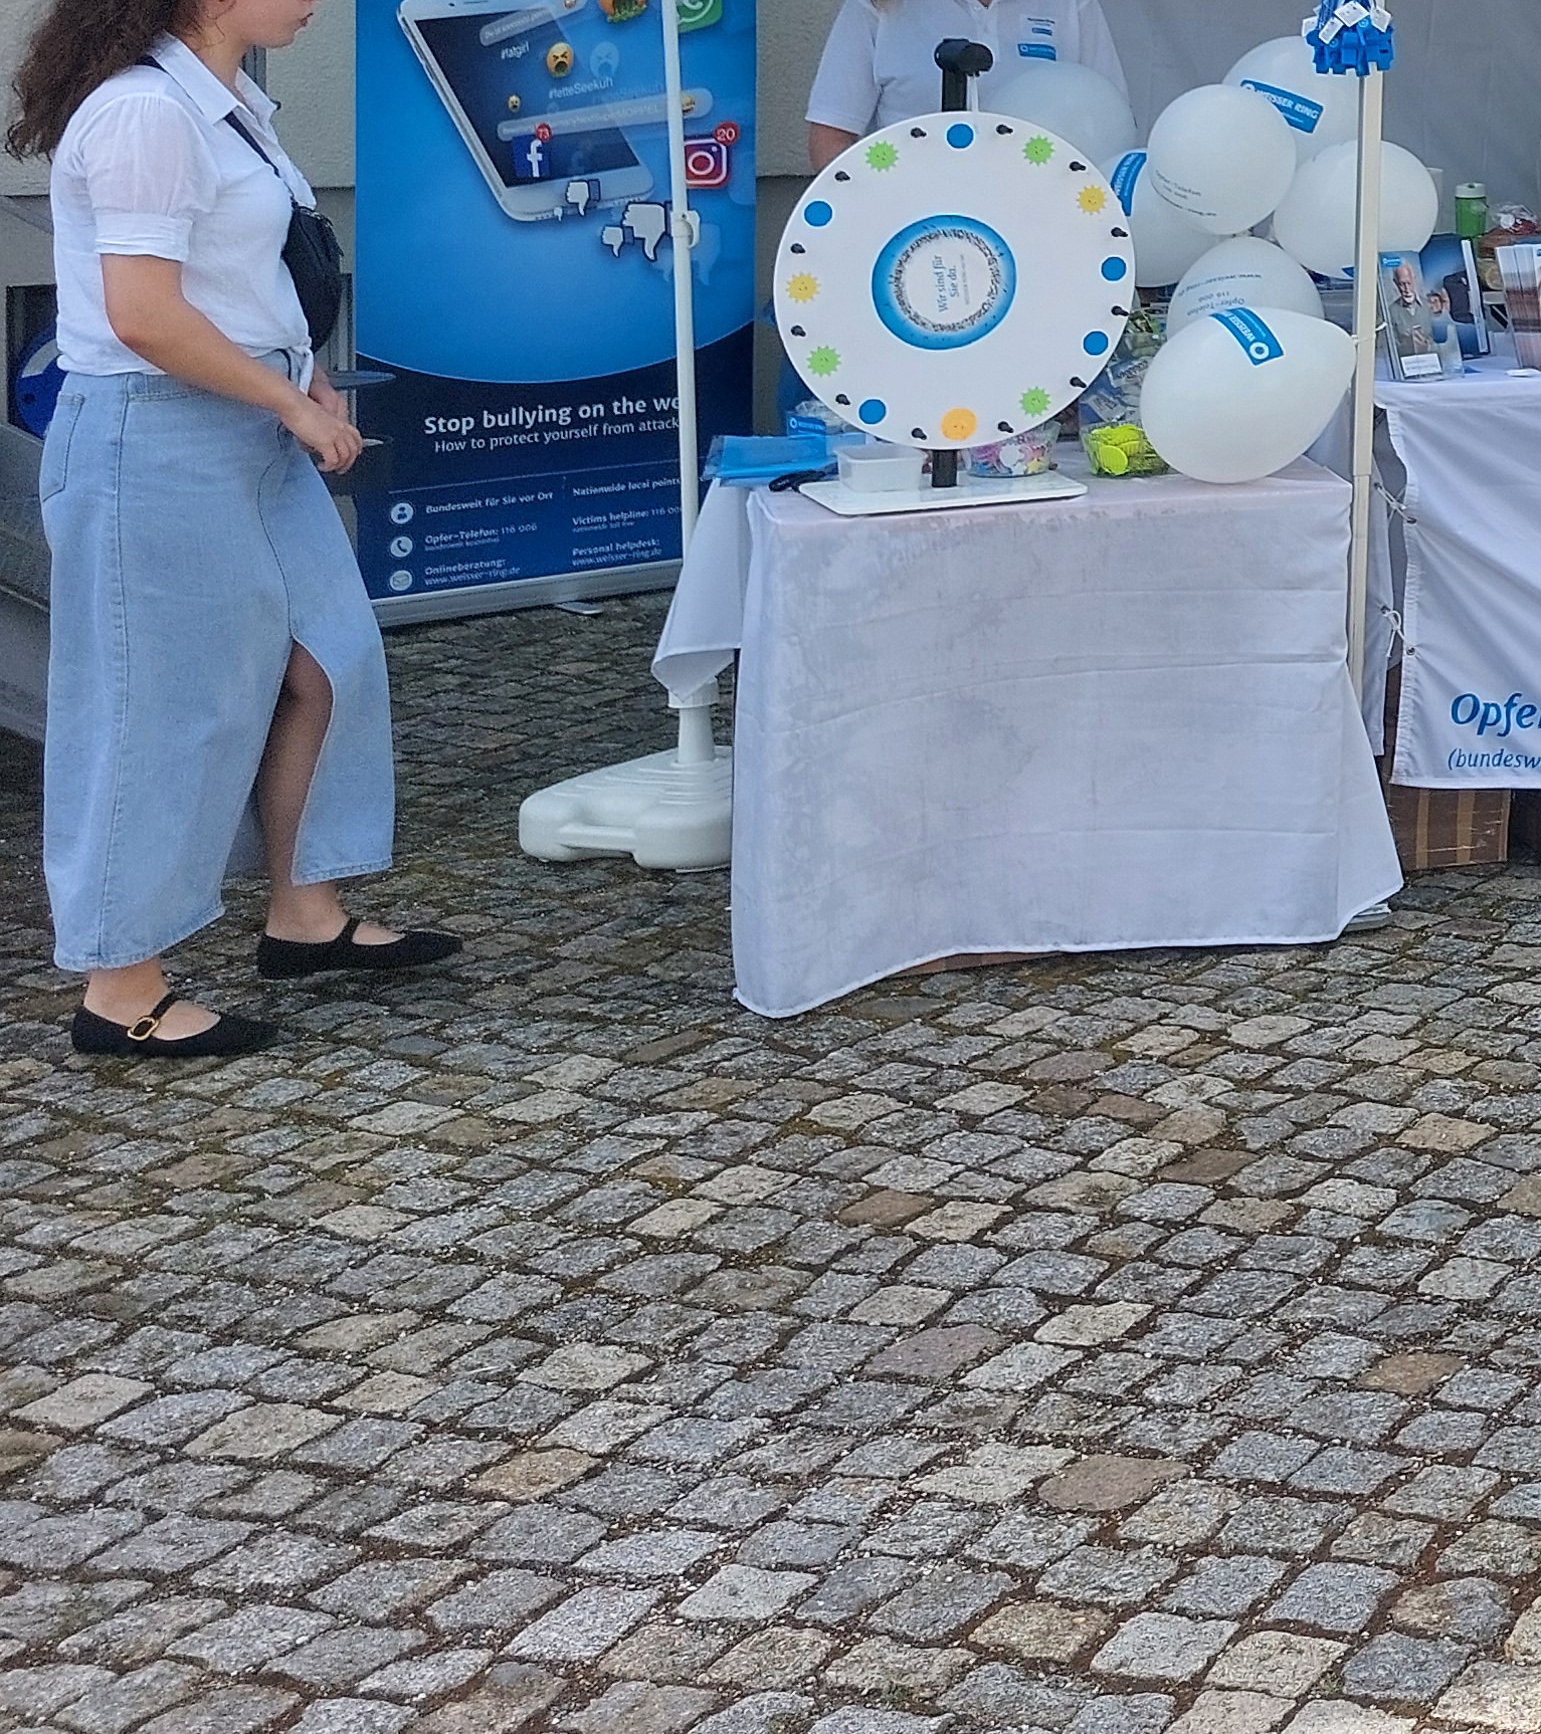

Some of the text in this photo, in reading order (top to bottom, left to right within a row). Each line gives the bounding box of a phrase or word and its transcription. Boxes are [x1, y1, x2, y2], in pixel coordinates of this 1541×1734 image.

[1294, 102, 1320, 120] RING
[717, 124, 737, 142] 20
[424, 396, 680, 435] Stop bullying on the we
[434, 416, 681, 454] How to protect yourself from attack
[572, 484, 627, 497] Nationwide
[628, 478, 650, 491] local
[425, 499, 483, 514] Bundesweit
[502, 495, 517, 505] Sie
[518, 494, 535, 504] vor
[572, 515, 607, 526] Victims
